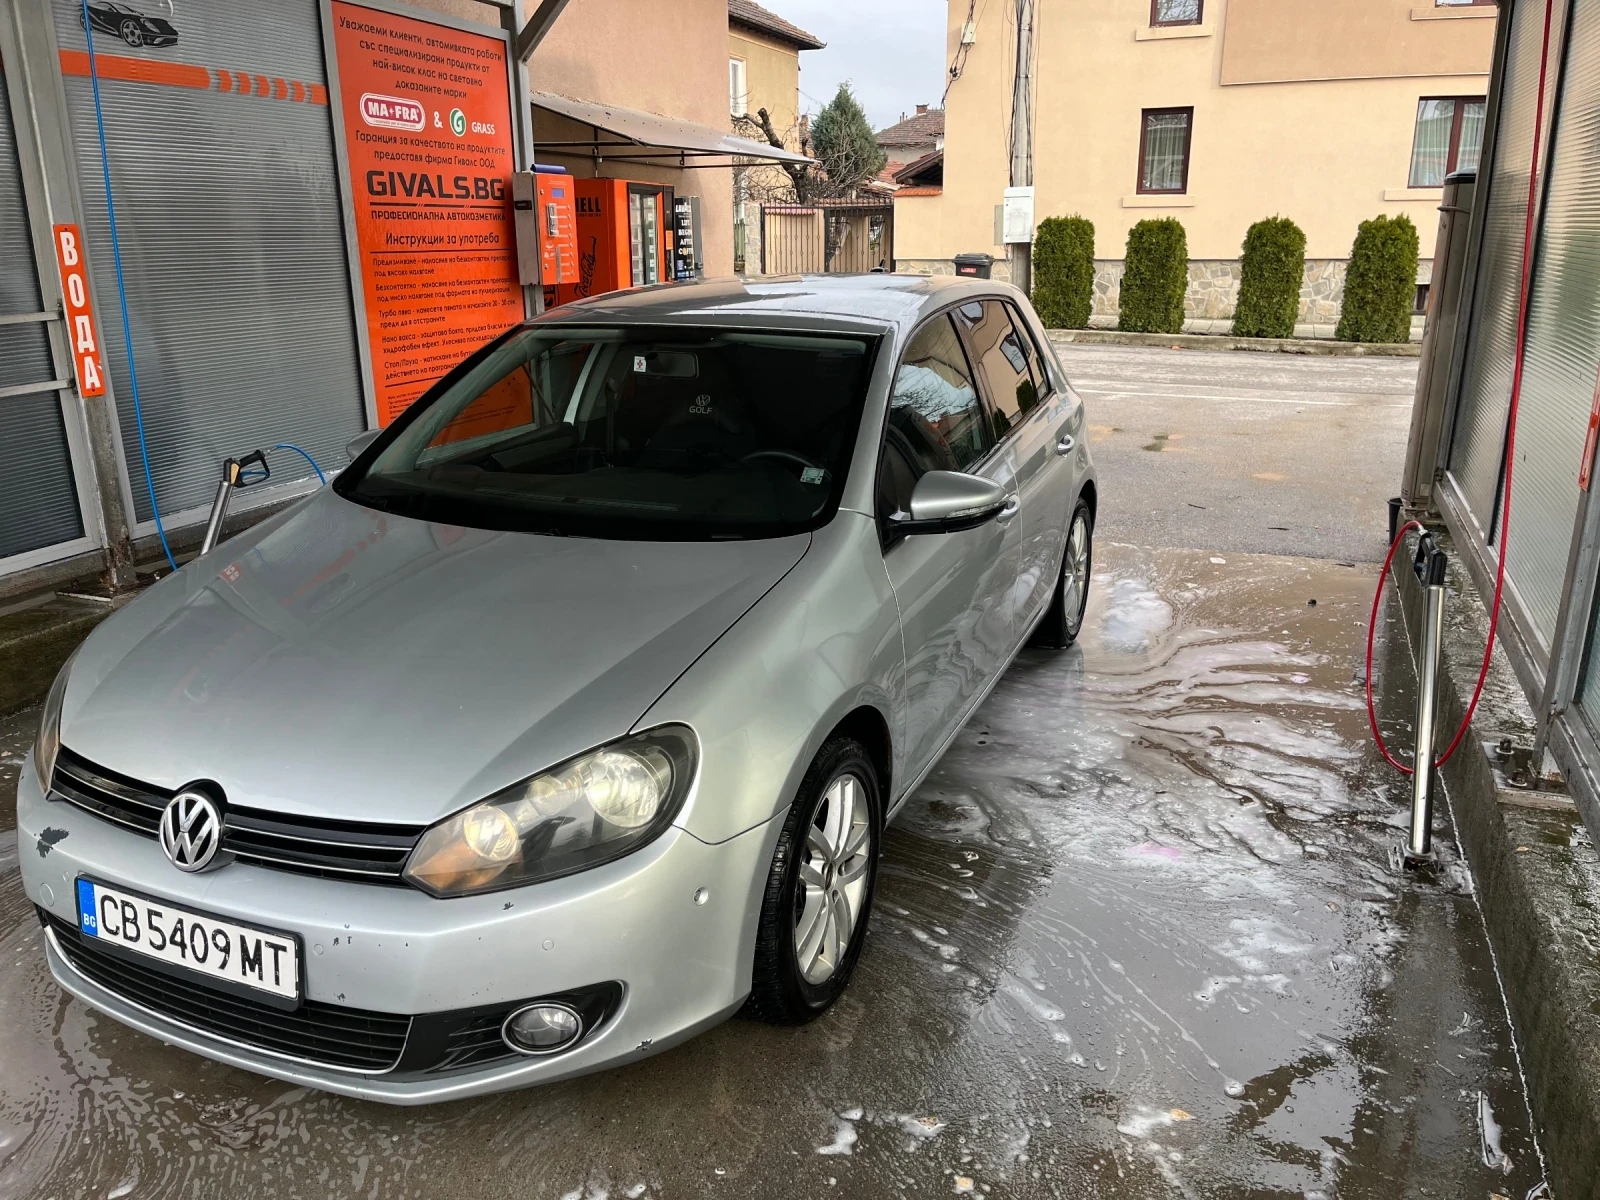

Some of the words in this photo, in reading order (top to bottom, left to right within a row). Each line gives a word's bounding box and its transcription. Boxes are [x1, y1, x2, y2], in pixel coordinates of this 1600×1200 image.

[340, 16, 387, 37] Уважаеми
[426, 37, 474, 55] автомивката
[476, 48, 502, 62] работи
[360, 40, 376, 51] със
[378, 44, 445, 64] специализирани
[447, 57, 480, 72] продукти
[482, 65, 490, 73] от
[372, 58, 416, 75] най-висок
[417, 68, 436, 79] клас
[438, 71, 448, 80] на
[449, 74, 483, 87] световно
[395, 80, 442, 94] доказаните
[443, 89, 467, 99] марки
[471, 122, 495, 135] GRASS
[355, 130, 397, 144] Гаранция
[399, 136, 408, 145] за
[410, 138, 454, 150] качеството
[466, 144, 506, 155] продуктите
[374, 150, 423, 162] предоставя
[424, 153, 452, 166] фирма
[454, 155, 477, 166] Гивалс
[479, 158, 495, 169] ООД
[367, 170, 505, 200] GIVALS.BG
[371, 210, 445, 220] ПРОФЕСИОНАЛНА
[447, 211, 506, 221] АВТОКОЗМЕТИКА
[386, 232, 444, 246] Инструкции
[447, 234, 456, 243] за
[459, 232, 499, 246] употреба
[446, 289, 470, 298] формата
[60, 231, 101, 390] ВОДА
[379, 309, 397, 318] Турбо
[413, 316, 445, 324] отстраните
[383, 343, 420, 354] хидрофобен
[424, 353, 452, 363] натискане
[385, 368, 419, 380] действието
[689, 405, 713, 414] GOLF
[83, 913, 96, 928] BG
